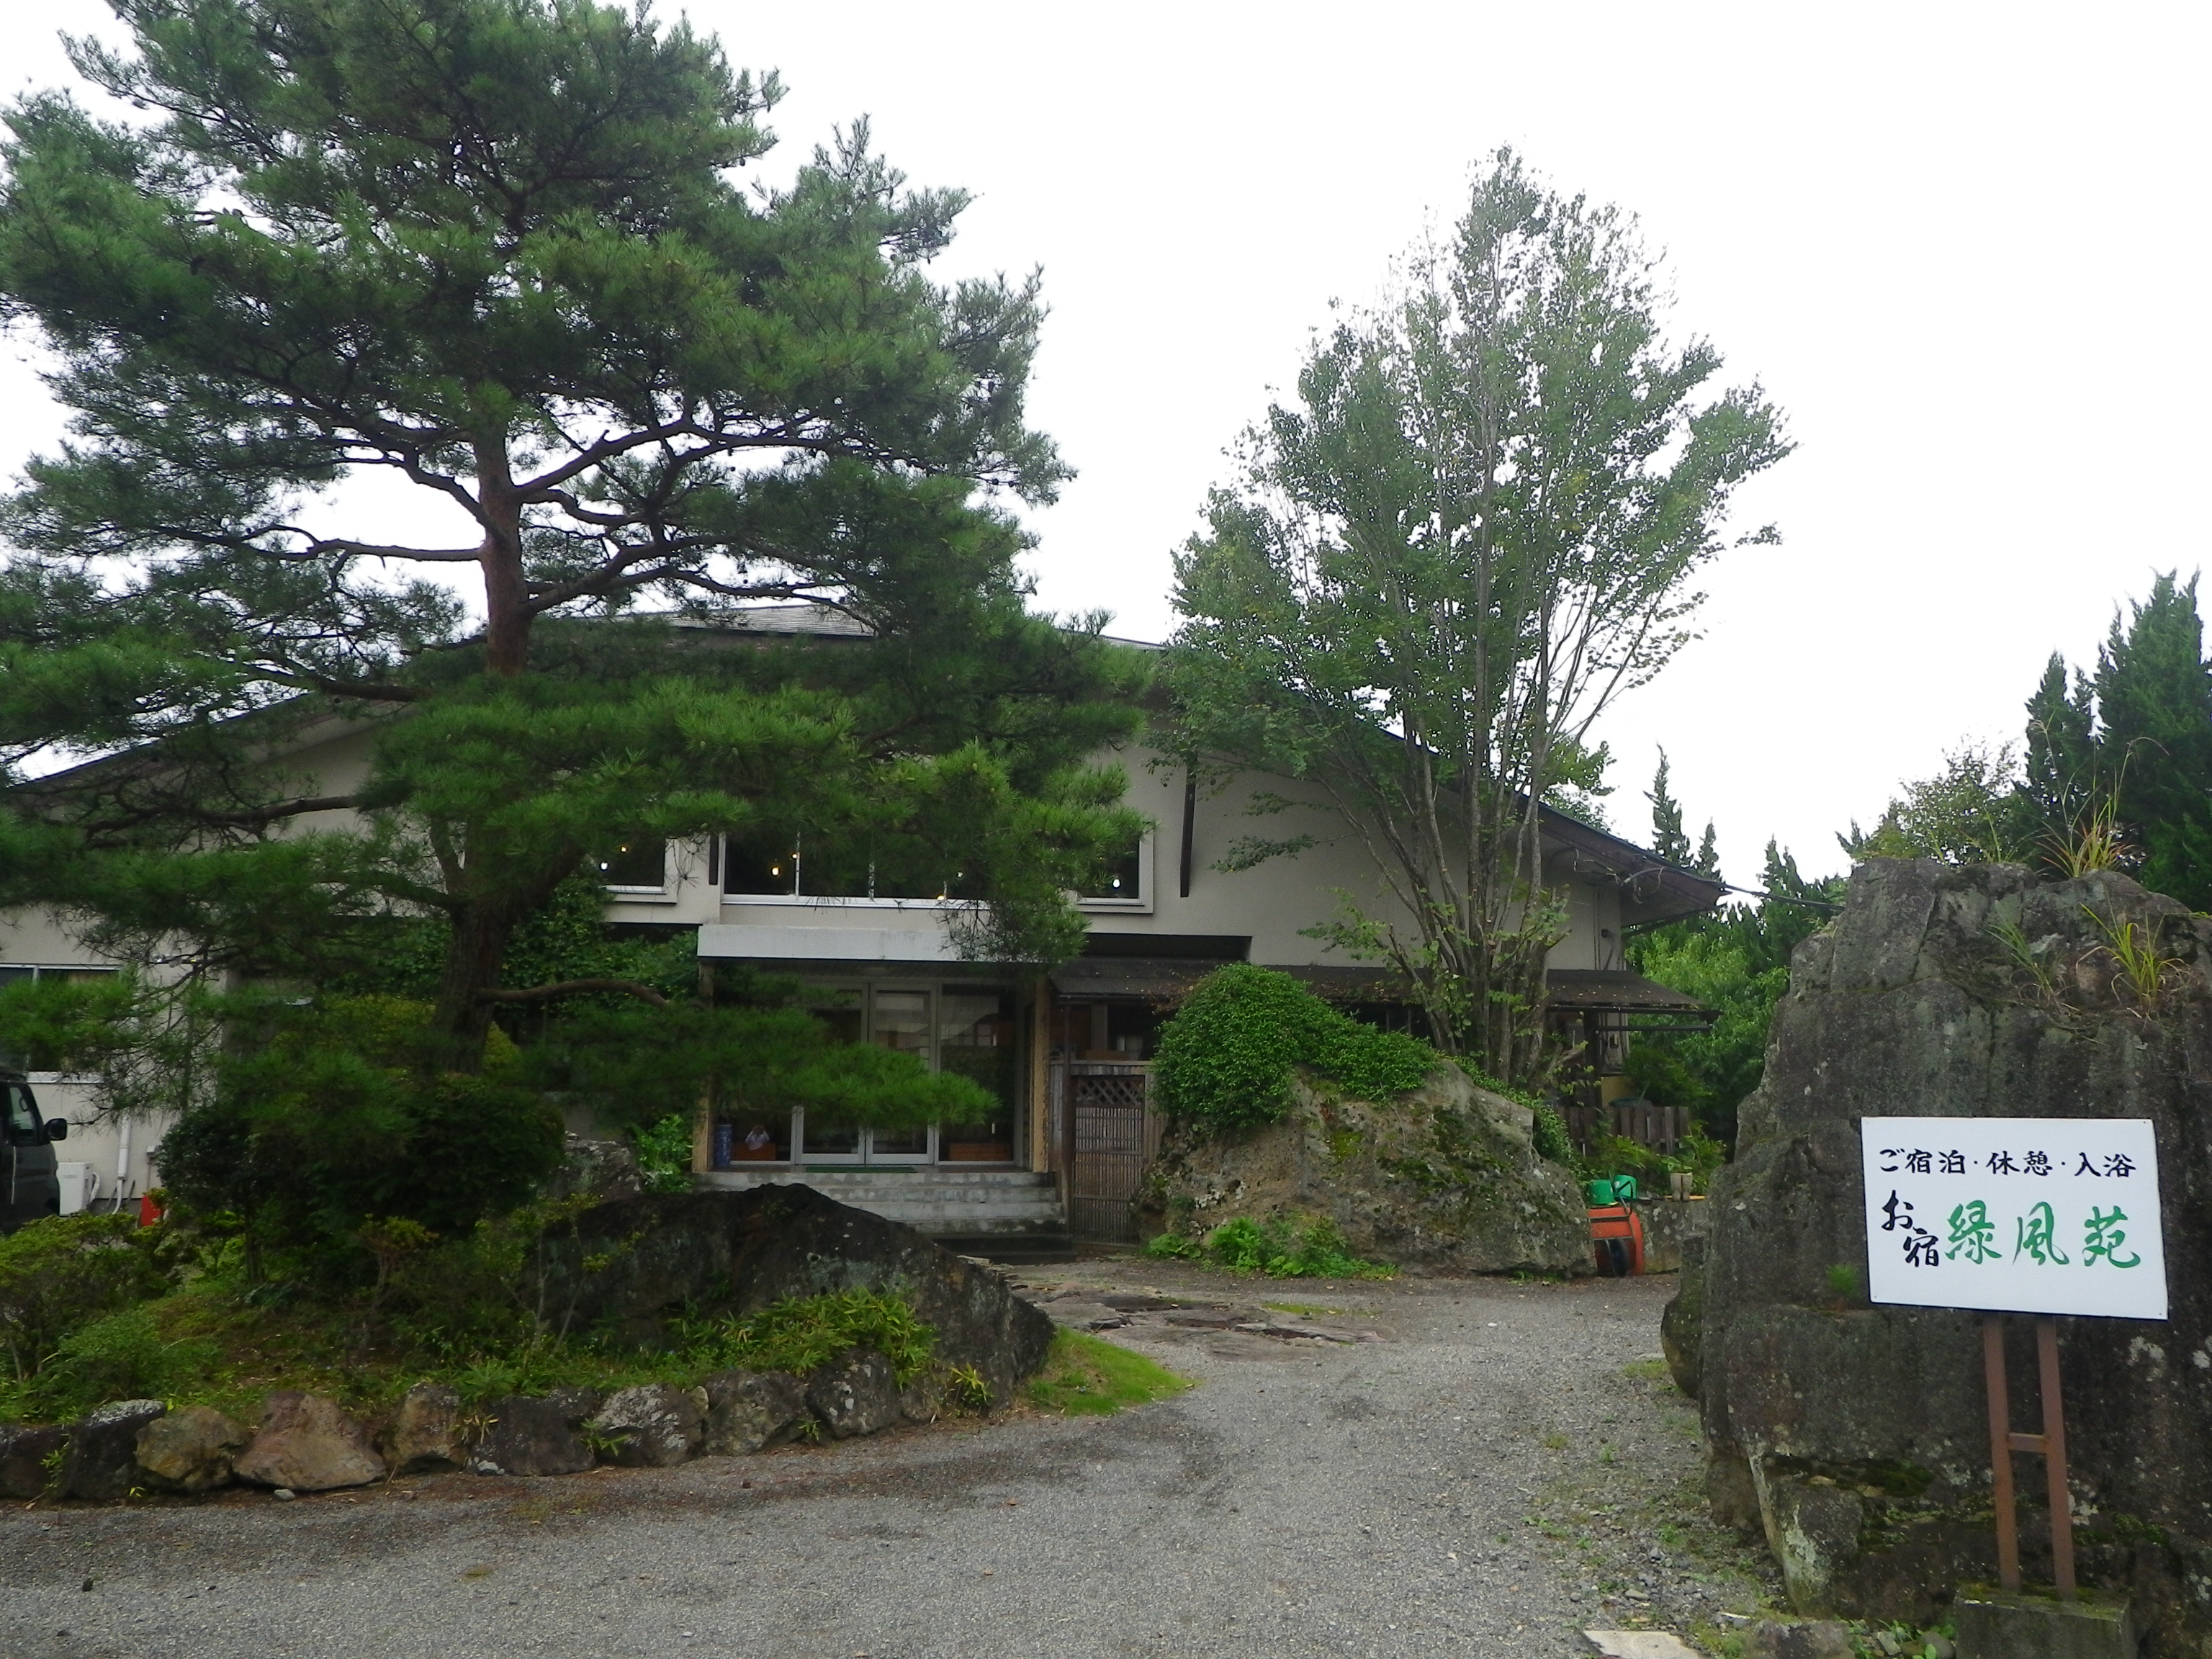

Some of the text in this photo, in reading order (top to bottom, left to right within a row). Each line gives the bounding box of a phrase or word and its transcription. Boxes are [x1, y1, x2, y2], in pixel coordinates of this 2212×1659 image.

[1881, 1189, 2141, 1269] お宿 緑風苑
